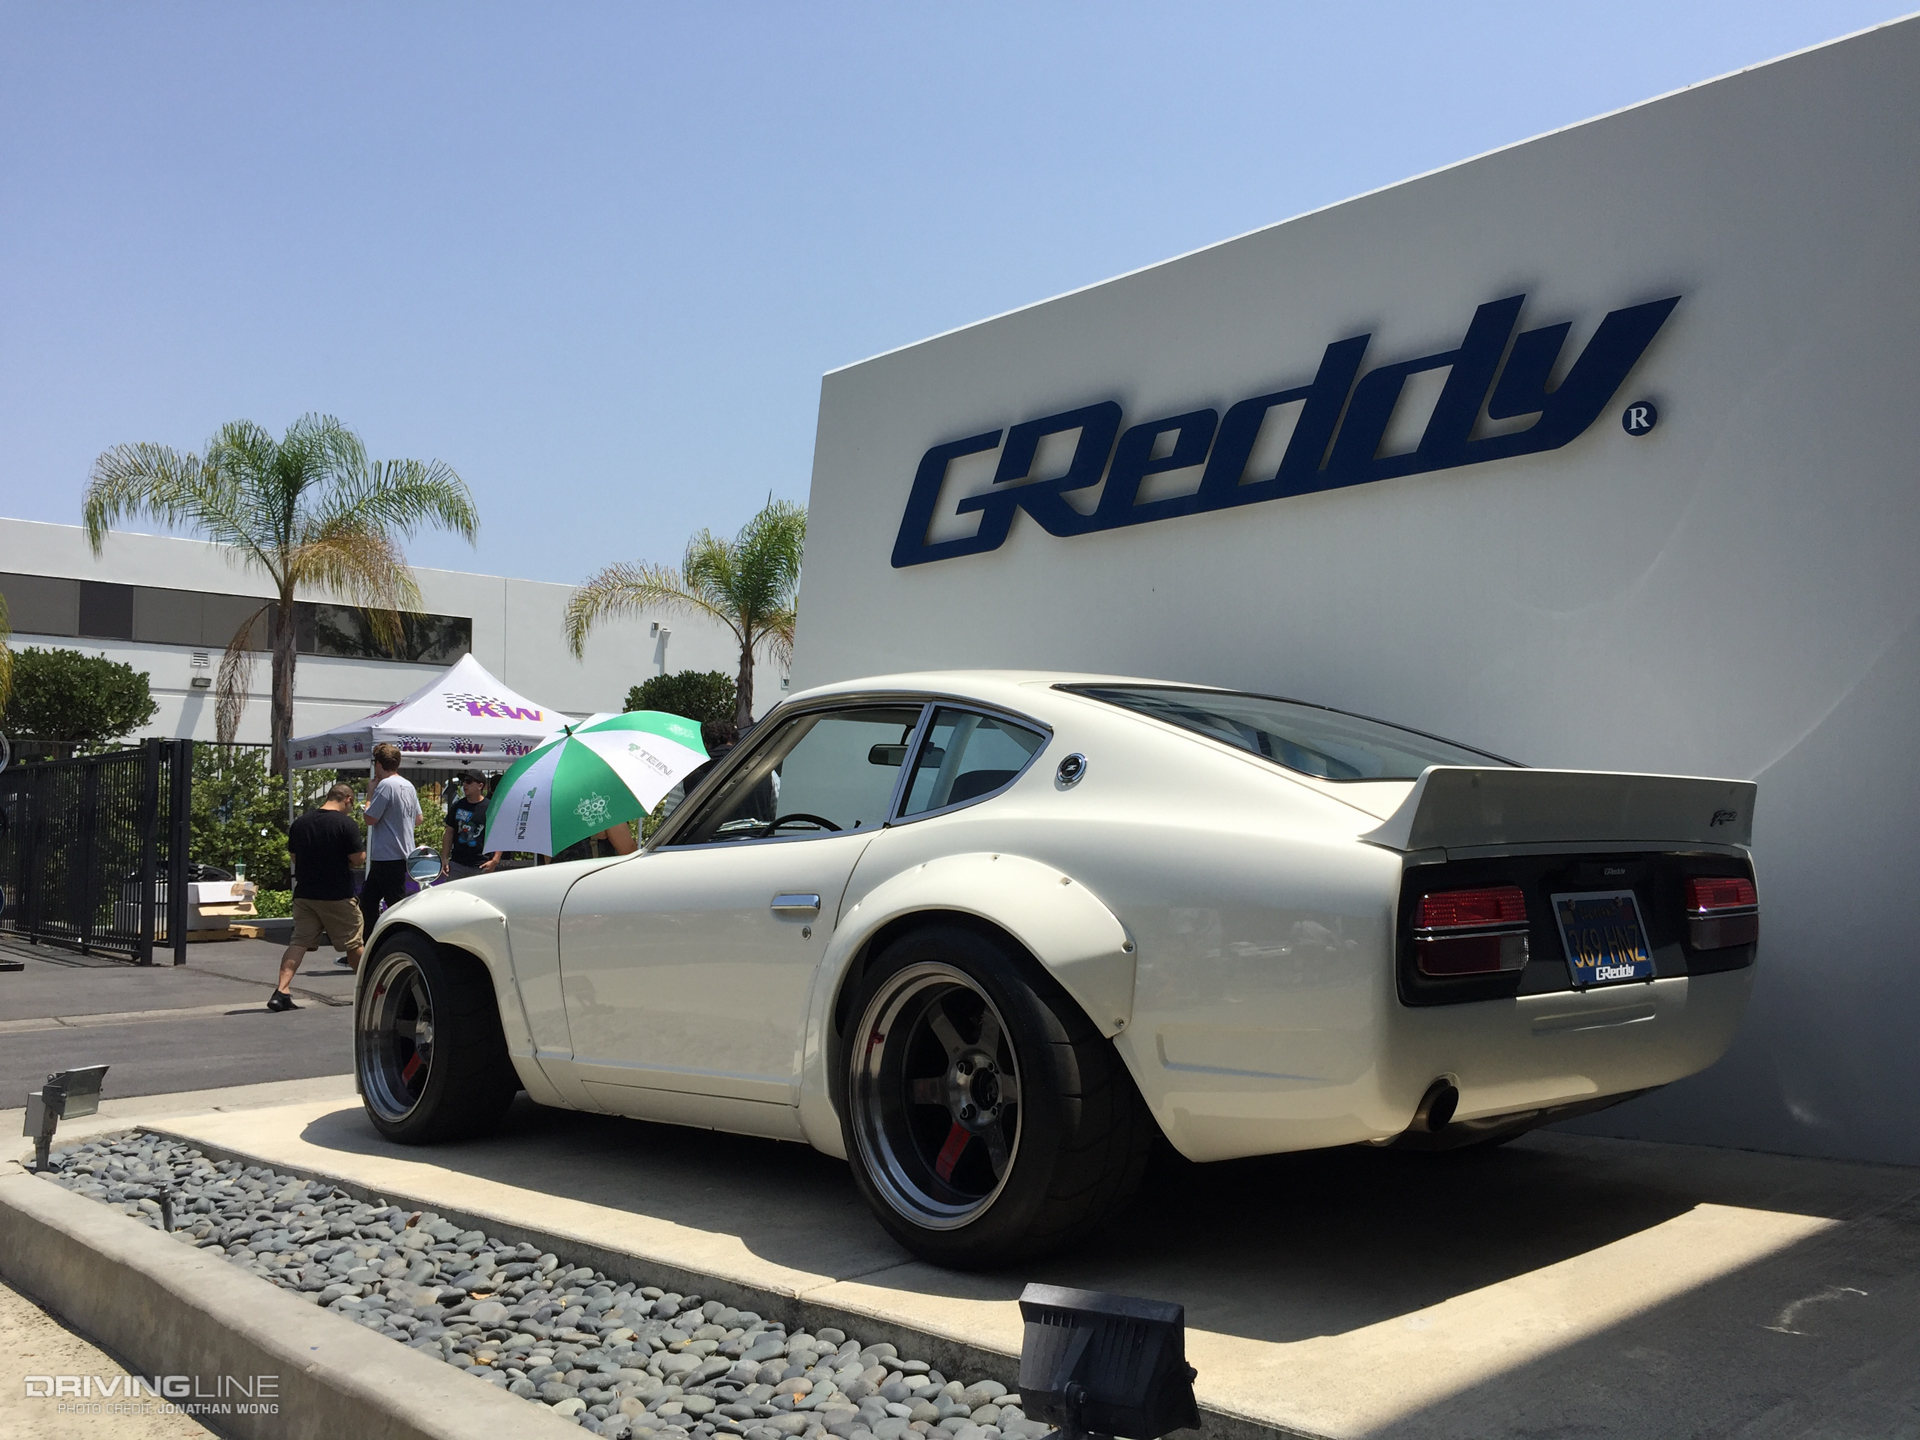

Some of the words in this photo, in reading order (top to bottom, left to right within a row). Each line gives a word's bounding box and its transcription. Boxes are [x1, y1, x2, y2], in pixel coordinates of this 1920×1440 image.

[890, 293, 1683, 569] GReddy
[466, 701, 543, 722] KW
[401, 741, 432, 752] KW
[455, 743, 484, 754] KW
[640, 749, 674, 777] TEIN
[517, 800, 532, 840] TEIN
[1595, 963, 1635, 981] GReddy
